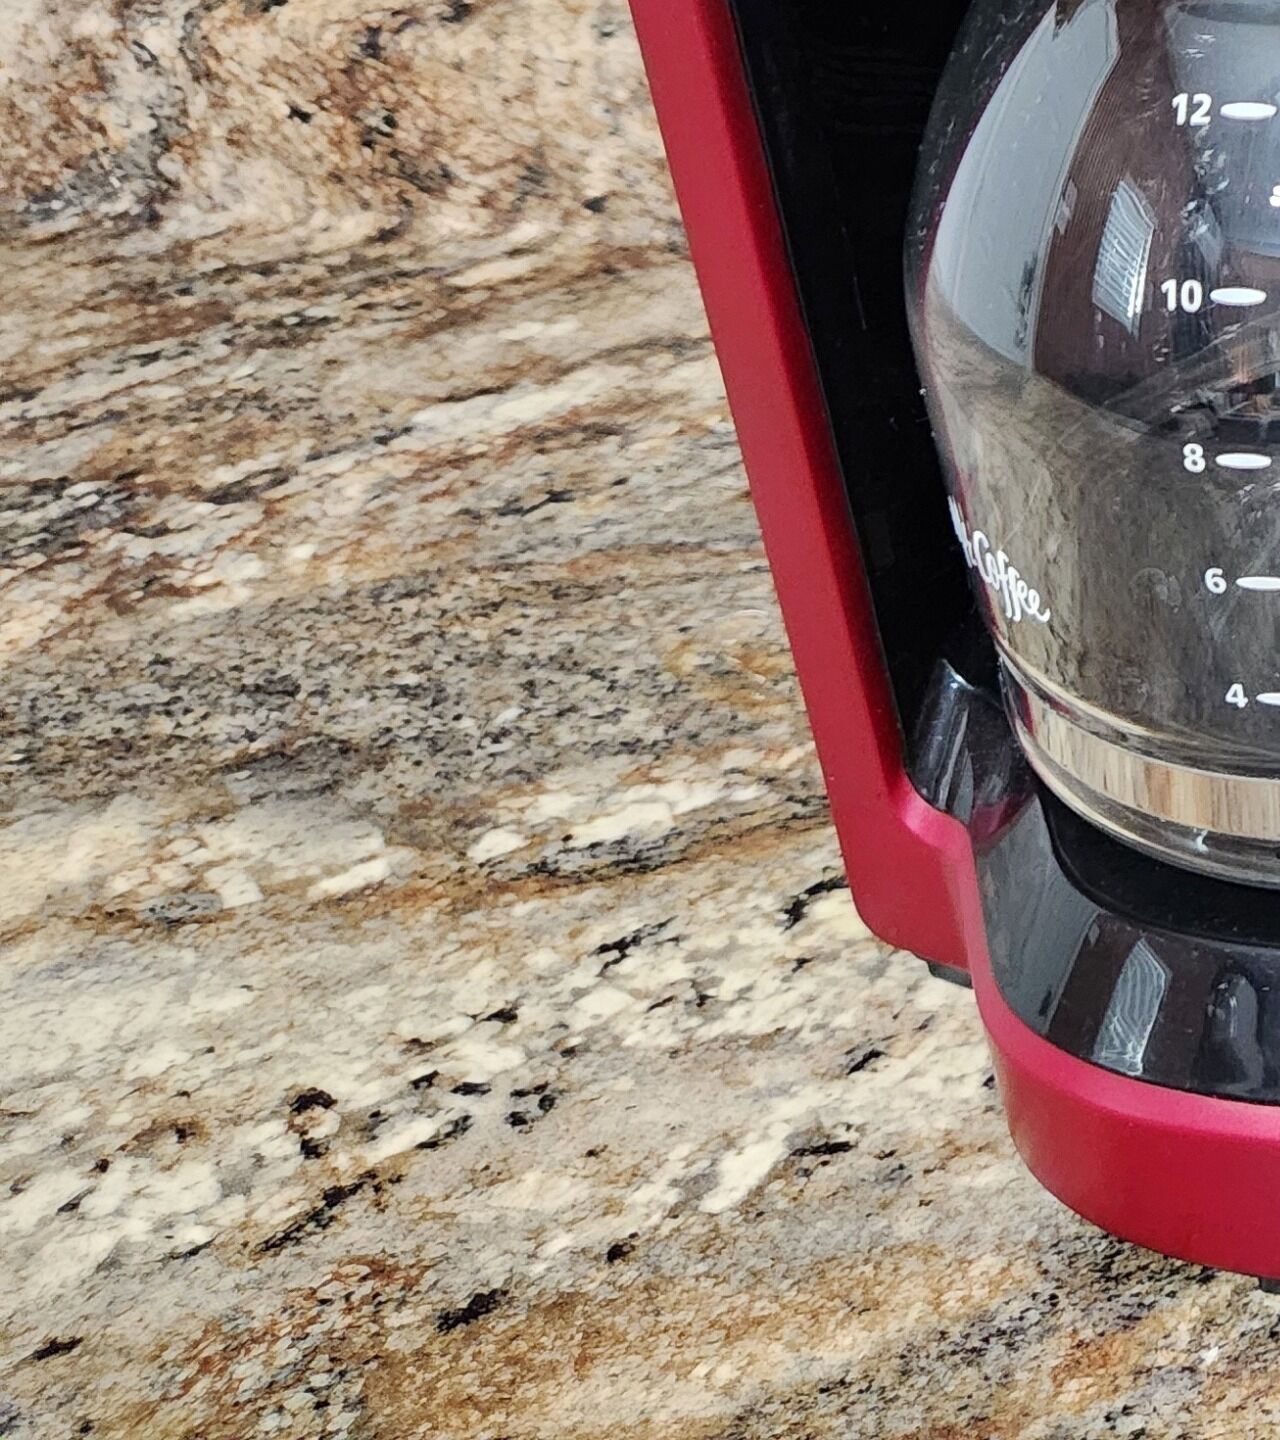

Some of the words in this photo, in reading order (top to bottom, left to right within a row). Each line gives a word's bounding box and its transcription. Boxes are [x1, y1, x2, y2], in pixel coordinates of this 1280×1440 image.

[1171, 93, 1213, 127] 12
[1161, 278, 1203, 313] 10
[1182, 442, 1207, 474] 8
[972, 529, 1051, 623] Coffee
[1203, 567, 1228, 595] 6
[1225, 682, 1249, 709] 4
